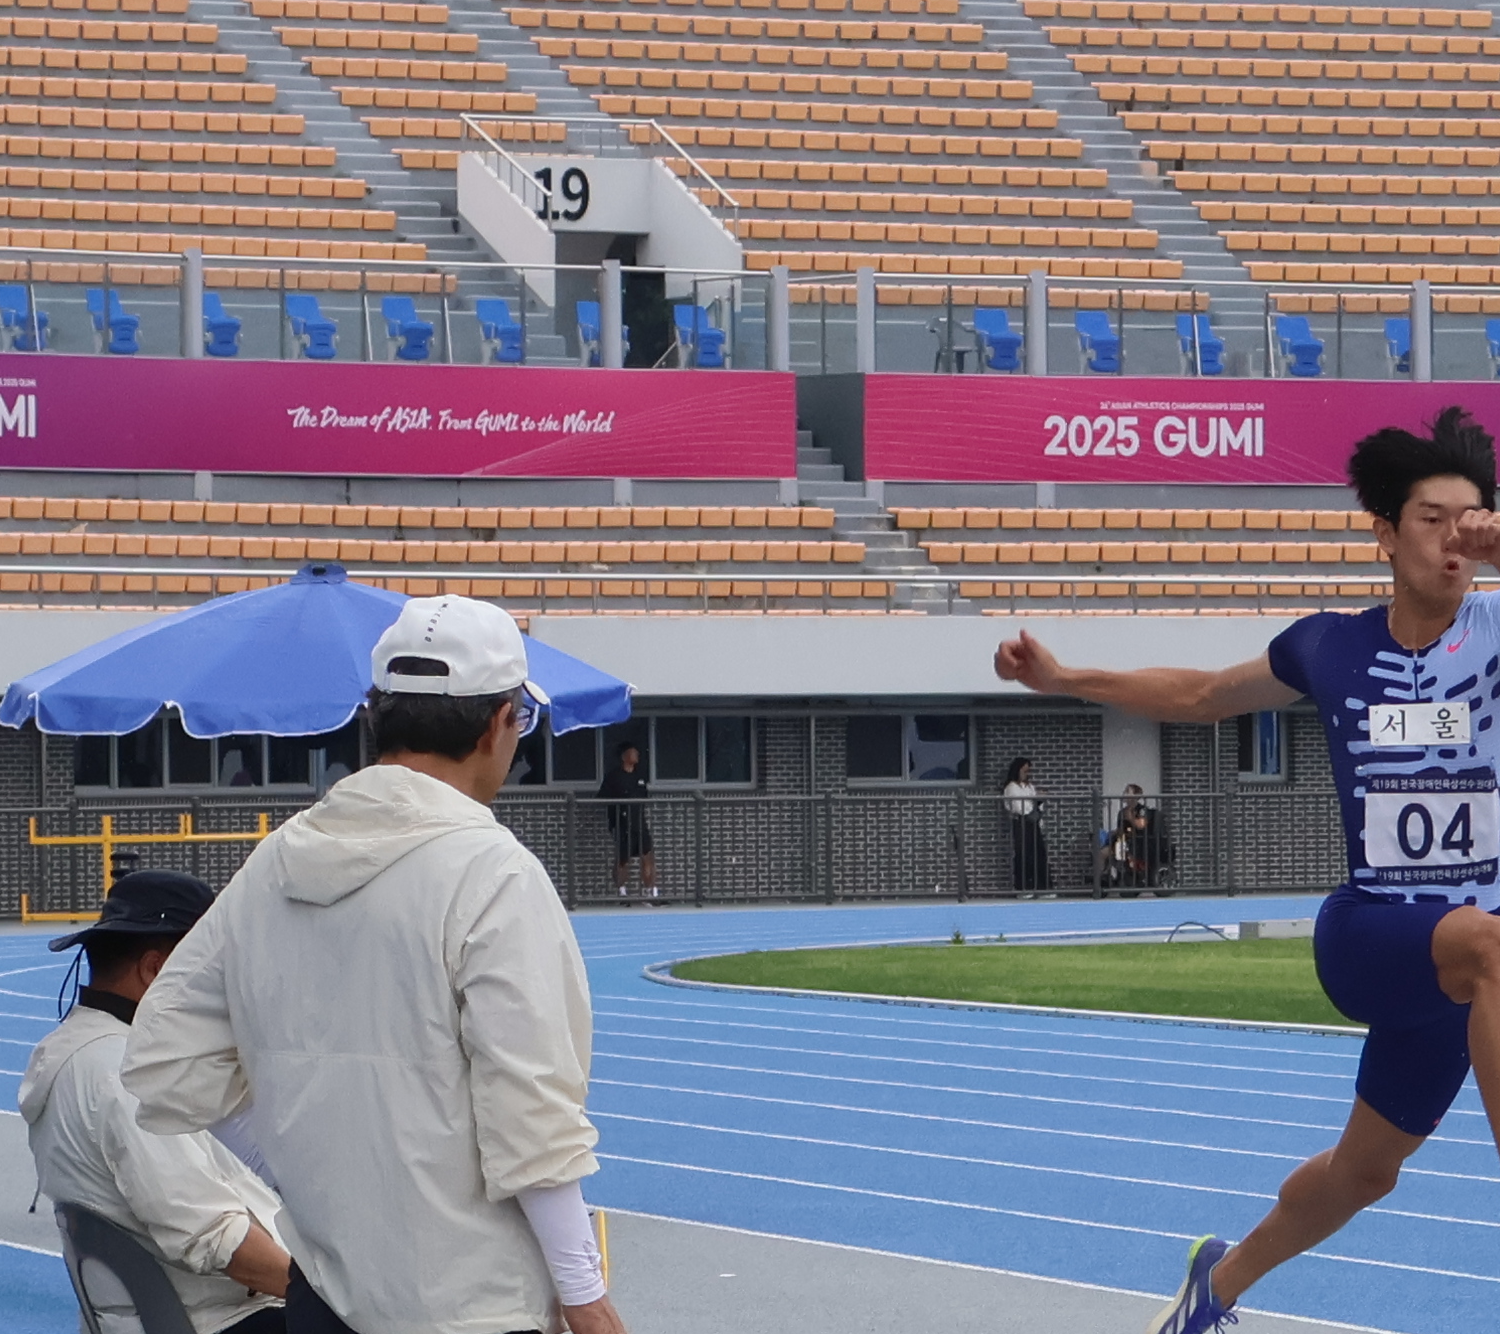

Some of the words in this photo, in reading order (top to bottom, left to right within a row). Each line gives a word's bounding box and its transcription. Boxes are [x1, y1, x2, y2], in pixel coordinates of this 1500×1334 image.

[534, 167, 590, 221] 19
[287, 406, 318, 428] The
[320, 406, 368, 428] Dream
[370, 406, 392, 433] of
[438, 409, 473, 431] From
[474, 409, 520, 436] GUMI
[521, 416, 536, 432] to
[537, 415, 561, 432] the
[562, 410, 615, 434] World
[1044, 415, 1140, 457] 2025
[1153, 415, 1265, 457] GUMI
[1380, 708, 1458, 741] 서울
[1397, 803, 1474, 860] 04
